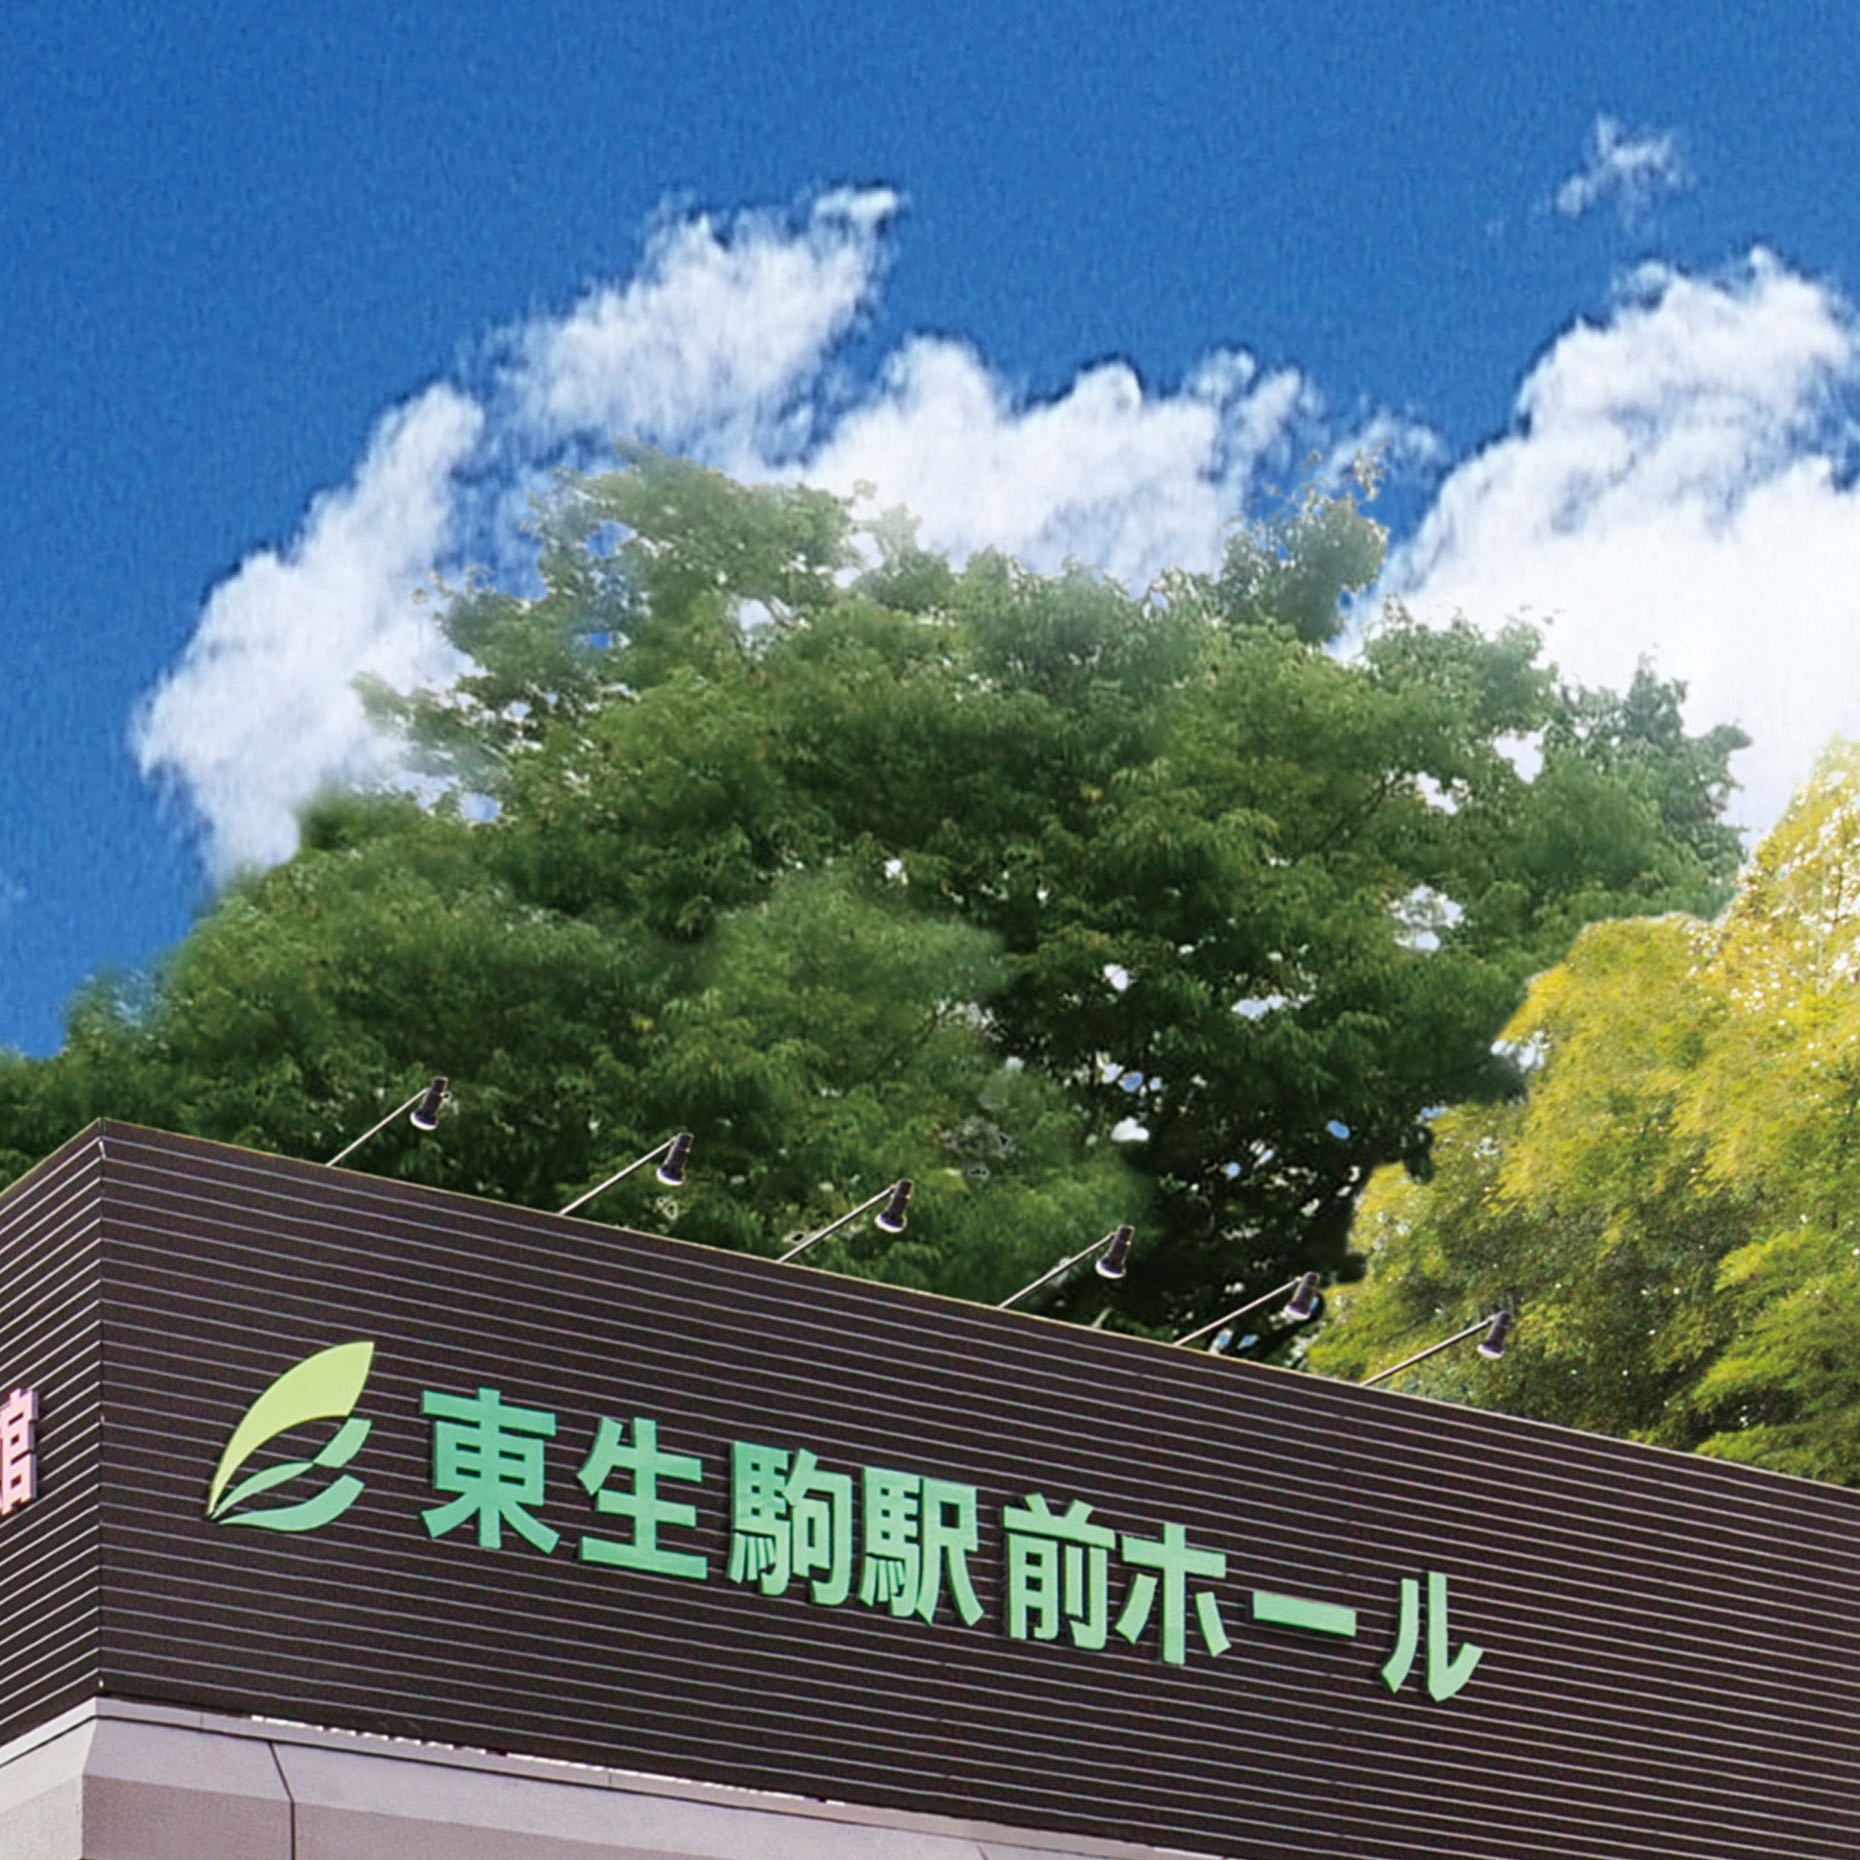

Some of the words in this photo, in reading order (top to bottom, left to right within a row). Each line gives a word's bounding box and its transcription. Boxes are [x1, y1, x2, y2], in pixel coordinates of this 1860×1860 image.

[419, 1387, 1485, 1702] 東生駒駅前ホール
